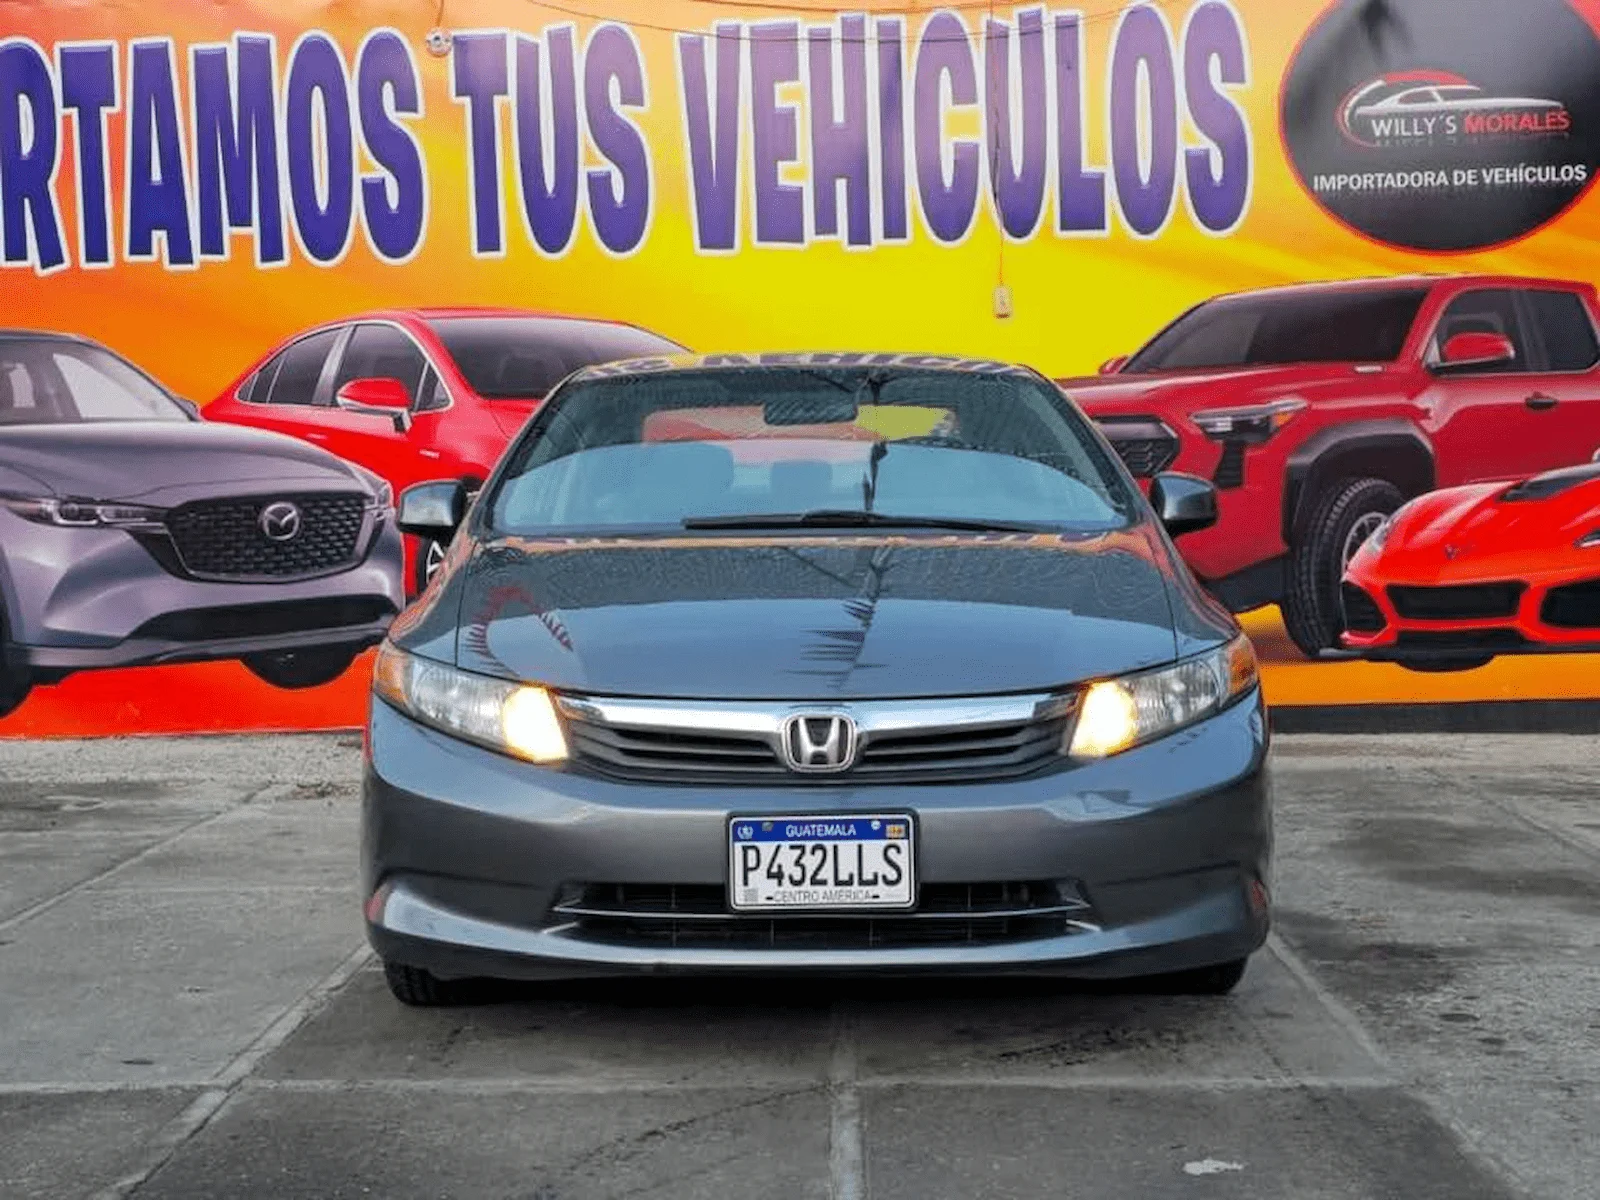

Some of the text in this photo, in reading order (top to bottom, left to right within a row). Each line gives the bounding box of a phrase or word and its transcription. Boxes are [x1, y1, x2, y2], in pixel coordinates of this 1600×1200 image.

[1464, 110, 1571, 134] MORALES
[0, 0, 1254, 274] RTAMOS TUS VEHICULOS
[1313, 163, 1587, 190] IMPORTADORA DE VEHÍCULOS
[785, 823, 857, 838] GUATEMALA
[741, 843, 903, 888] P432LLS
[773, 889, 820, 903] CENTRO
